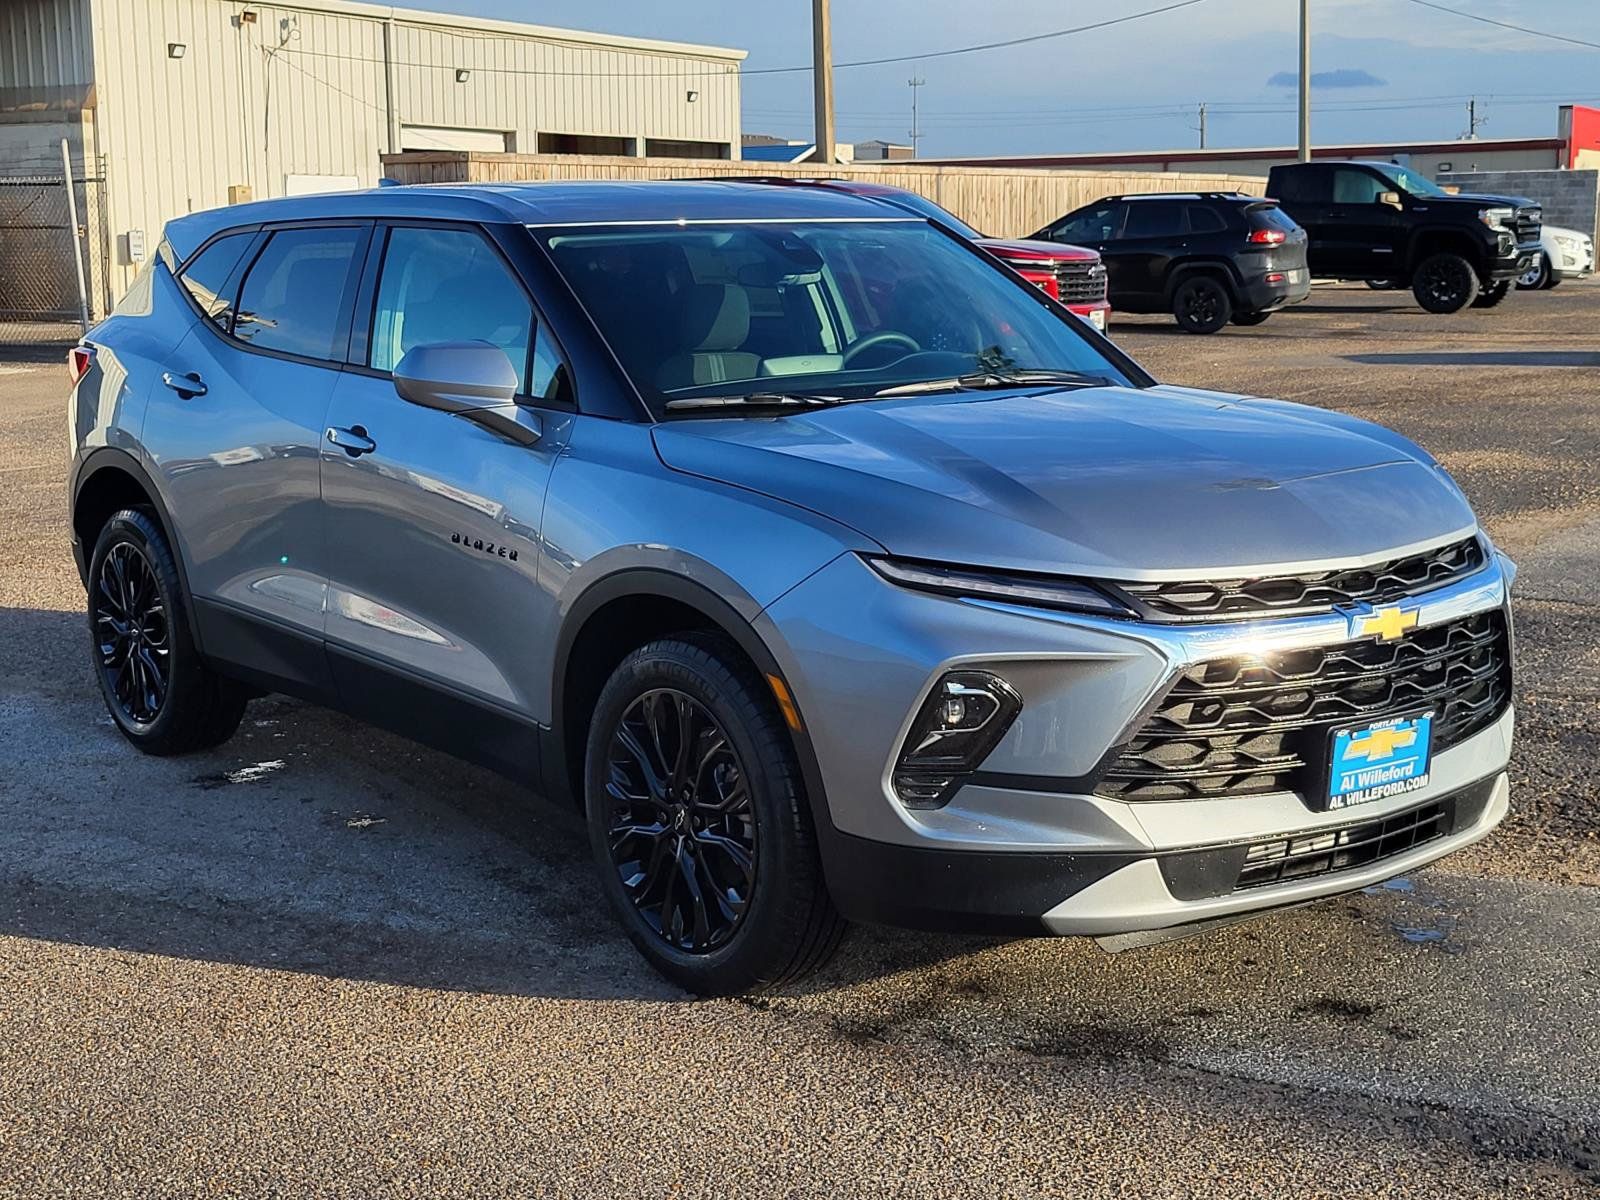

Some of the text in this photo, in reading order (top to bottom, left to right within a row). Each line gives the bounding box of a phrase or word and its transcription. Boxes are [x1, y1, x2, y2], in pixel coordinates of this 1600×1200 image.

[451, 532, 518, 561] BLAZER
[1368, 717, 1404, 731] PORTLAND
[1340, 762, 1414, 791] Al Willeford
[1329, 774, 1428, 809] AL WILLEFORD.COM
